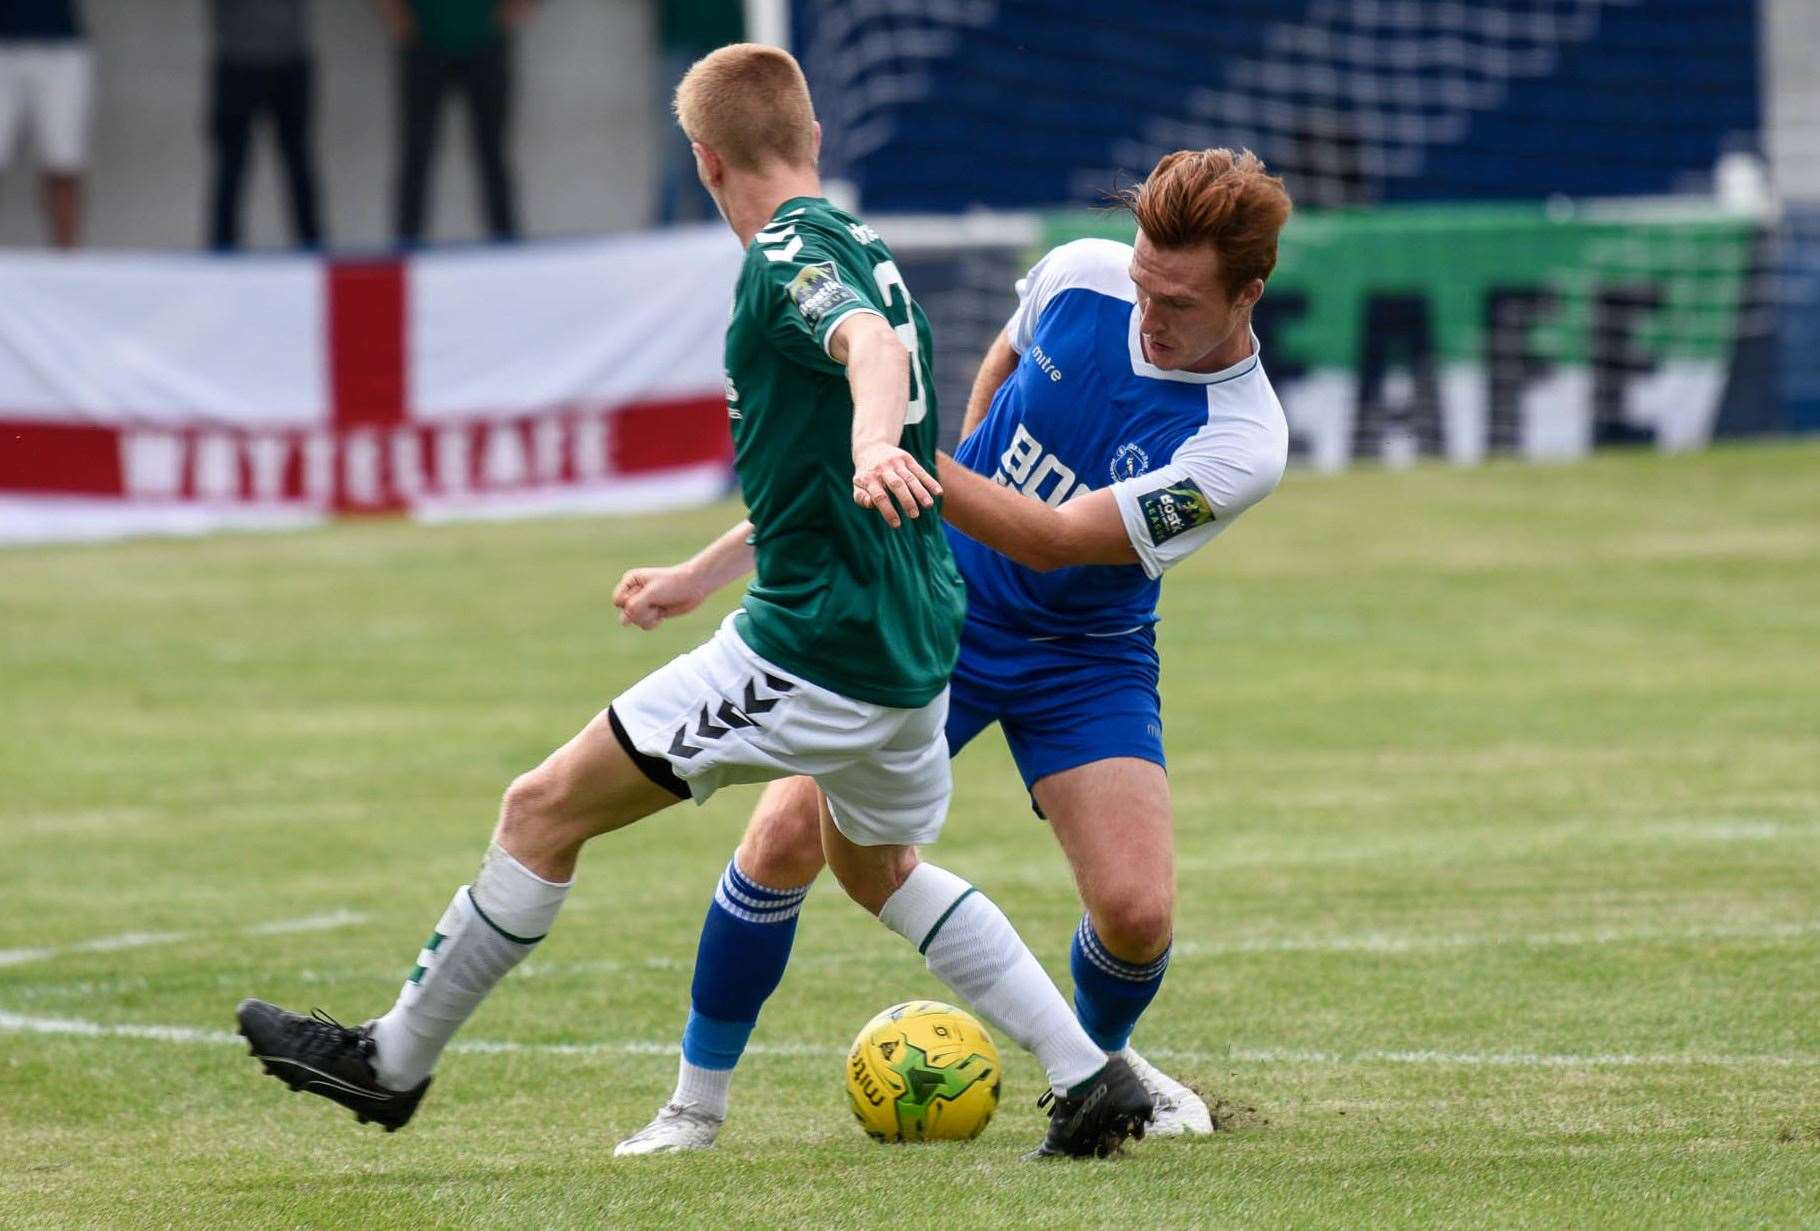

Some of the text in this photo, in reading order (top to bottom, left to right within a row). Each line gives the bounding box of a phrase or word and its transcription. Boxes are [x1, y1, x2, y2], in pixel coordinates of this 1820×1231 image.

[873, 260, 927, 425] 3
[1032, 344, 1062, 382] mitre
[1001, 423, 1092, 508] BO
